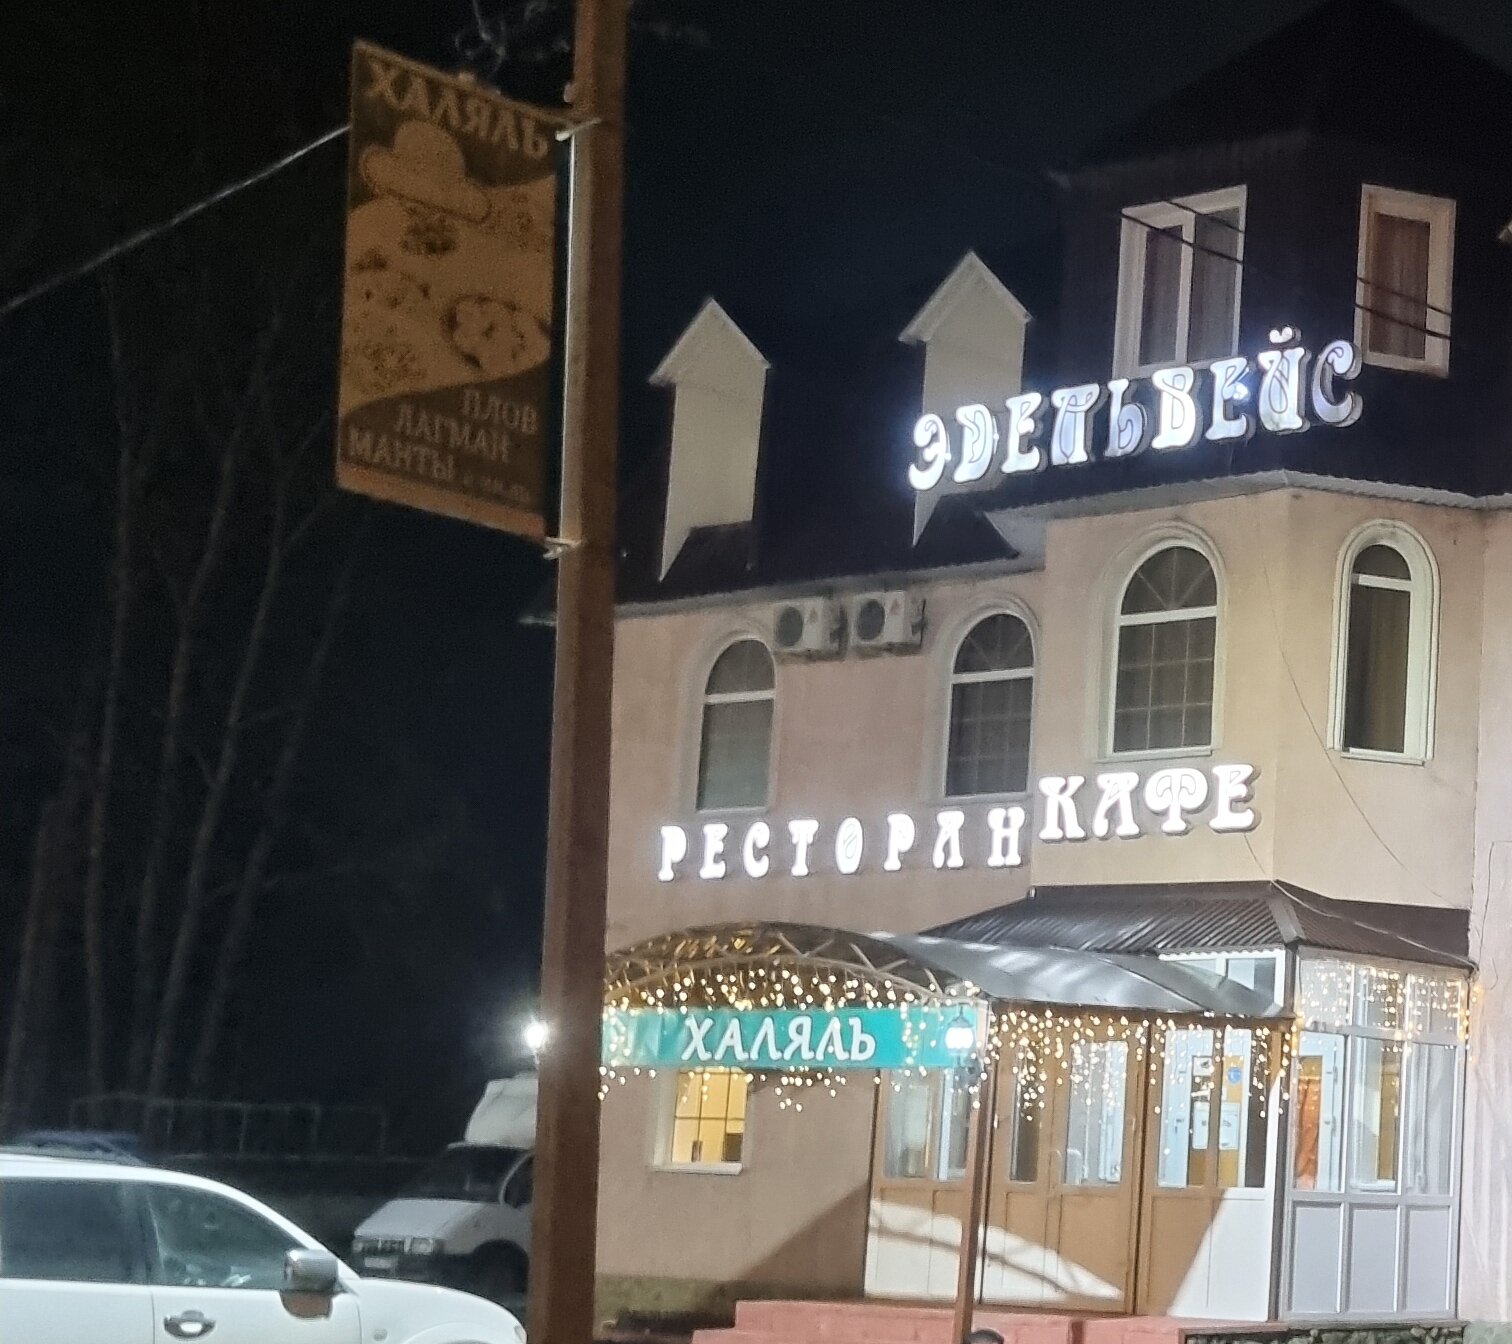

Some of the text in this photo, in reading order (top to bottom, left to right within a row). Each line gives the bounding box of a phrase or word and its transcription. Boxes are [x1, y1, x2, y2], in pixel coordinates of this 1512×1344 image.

[366, 58, 550, 160] ХАЛЯЛЬ
[906, 325, 1363, 492] ЭДЕЛЬВЕЙС
[1036, 762, 1258, 842] КАФЕ
[657, 805, 1026, 881] РЕСТОРАН
[680, 1014, 878, 1063] ХАЛЯЛЬ
